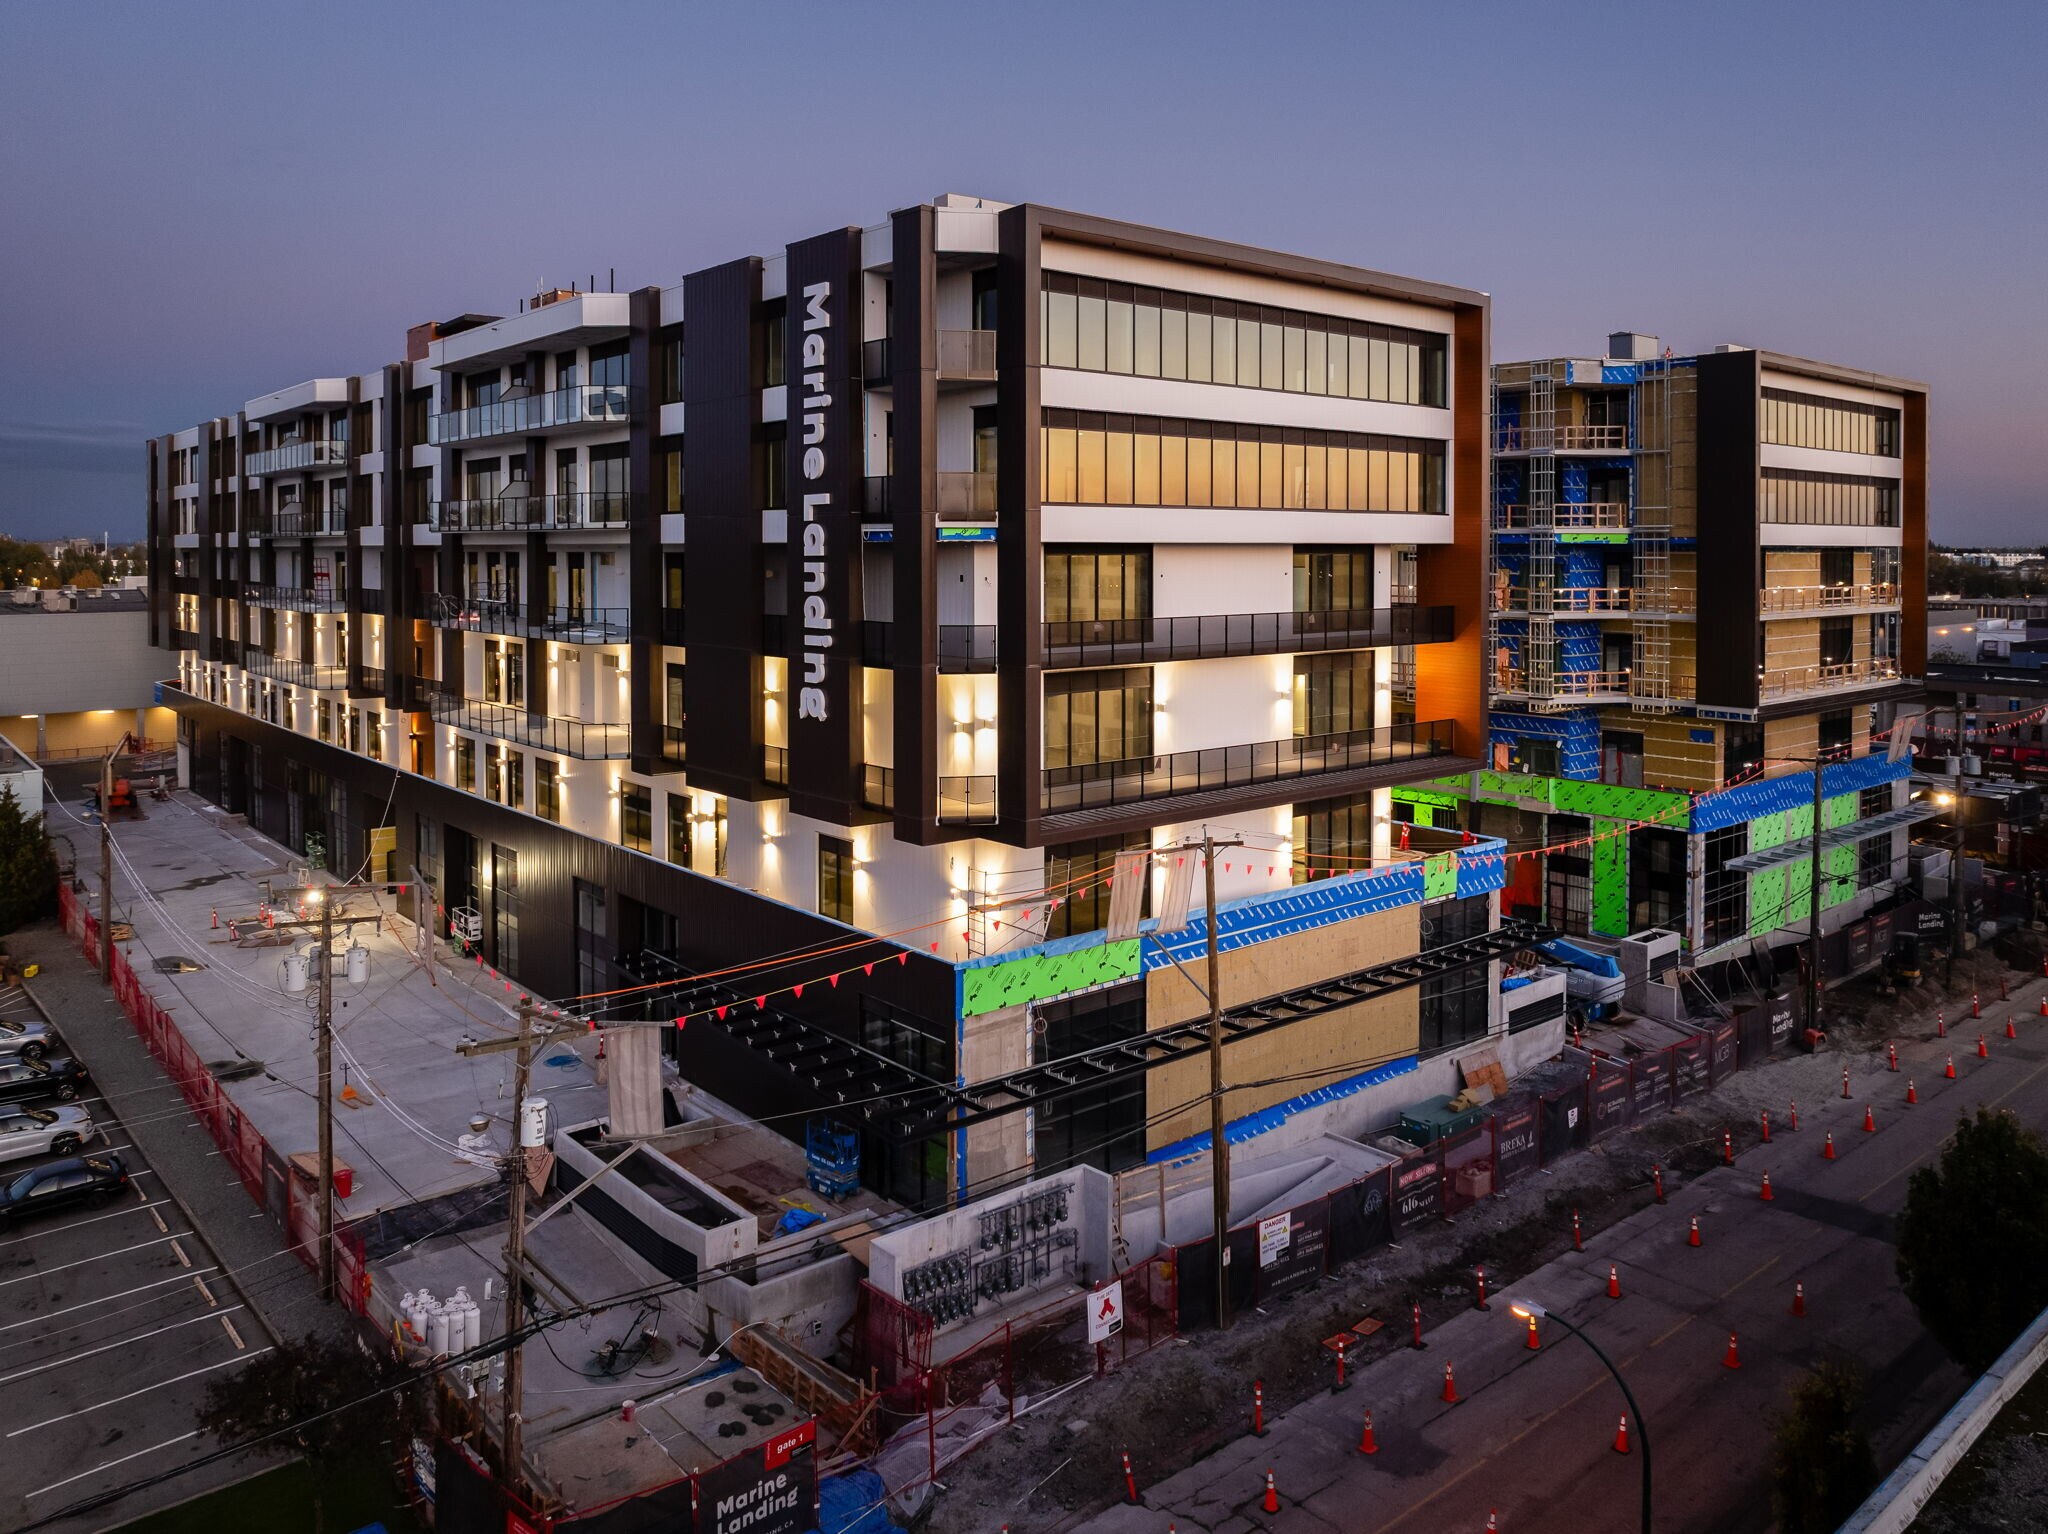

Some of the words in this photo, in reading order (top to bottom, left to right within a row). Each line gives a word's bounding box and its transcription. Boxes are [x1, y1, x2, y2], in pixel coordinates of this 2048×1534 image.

[803, 281, 832, 480] Marine
[799, 492, 833, 722] Landing
[1918, 912, 1941, 921] Marine
[1918, 920, 1945, 929] Landing
[1772, 1010, 1791, 1024] Marine
[1772, 1018, 1794, 1034] Landing
[1500, 1133, 1526, 1154] BREKA
[1400, 1174, 1413, 1187] NOW
[1264, 1216, 1286, 1229] DANGER
[777, 1438, 797, 1454] gate
[799, 1433, 804, 1441] 1
[716, 1473, 787, 1520] Marine
[716, 1486, 799, 1534] Landing
